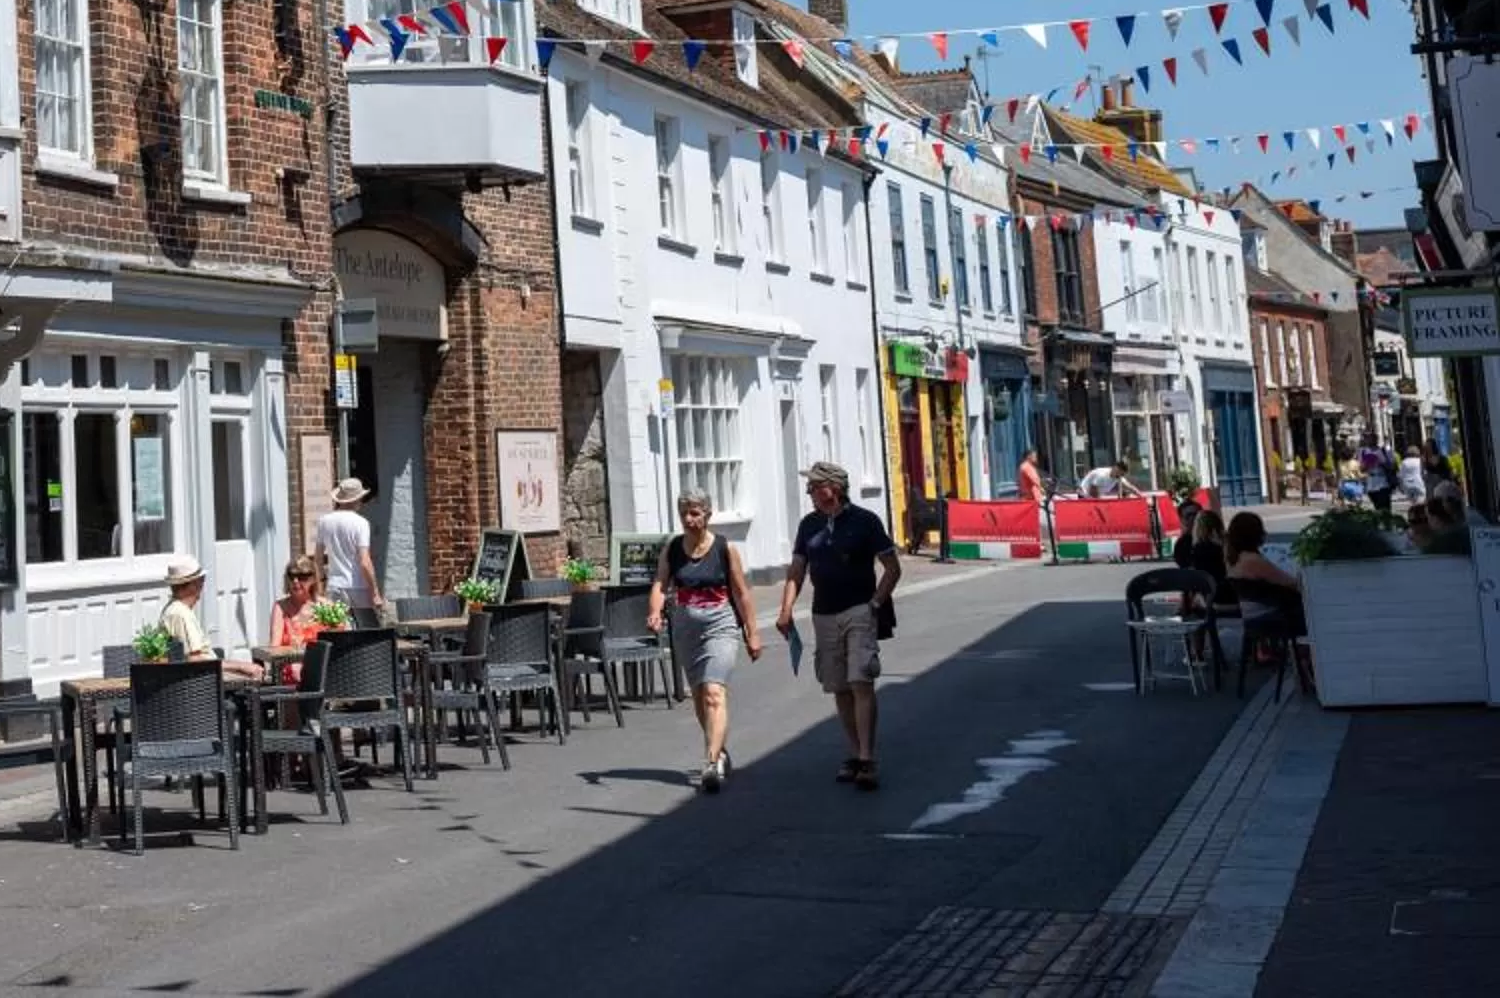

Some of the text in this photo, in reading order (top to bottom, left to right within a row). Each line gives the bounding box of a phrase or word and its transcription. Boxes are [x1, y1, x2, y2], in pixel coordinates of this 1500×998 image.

[365, 249, 423, 290] Antelope
[1415, 306, 1492, 321] PICTURE
[1413, 324, 1497, 340] FRAMING
